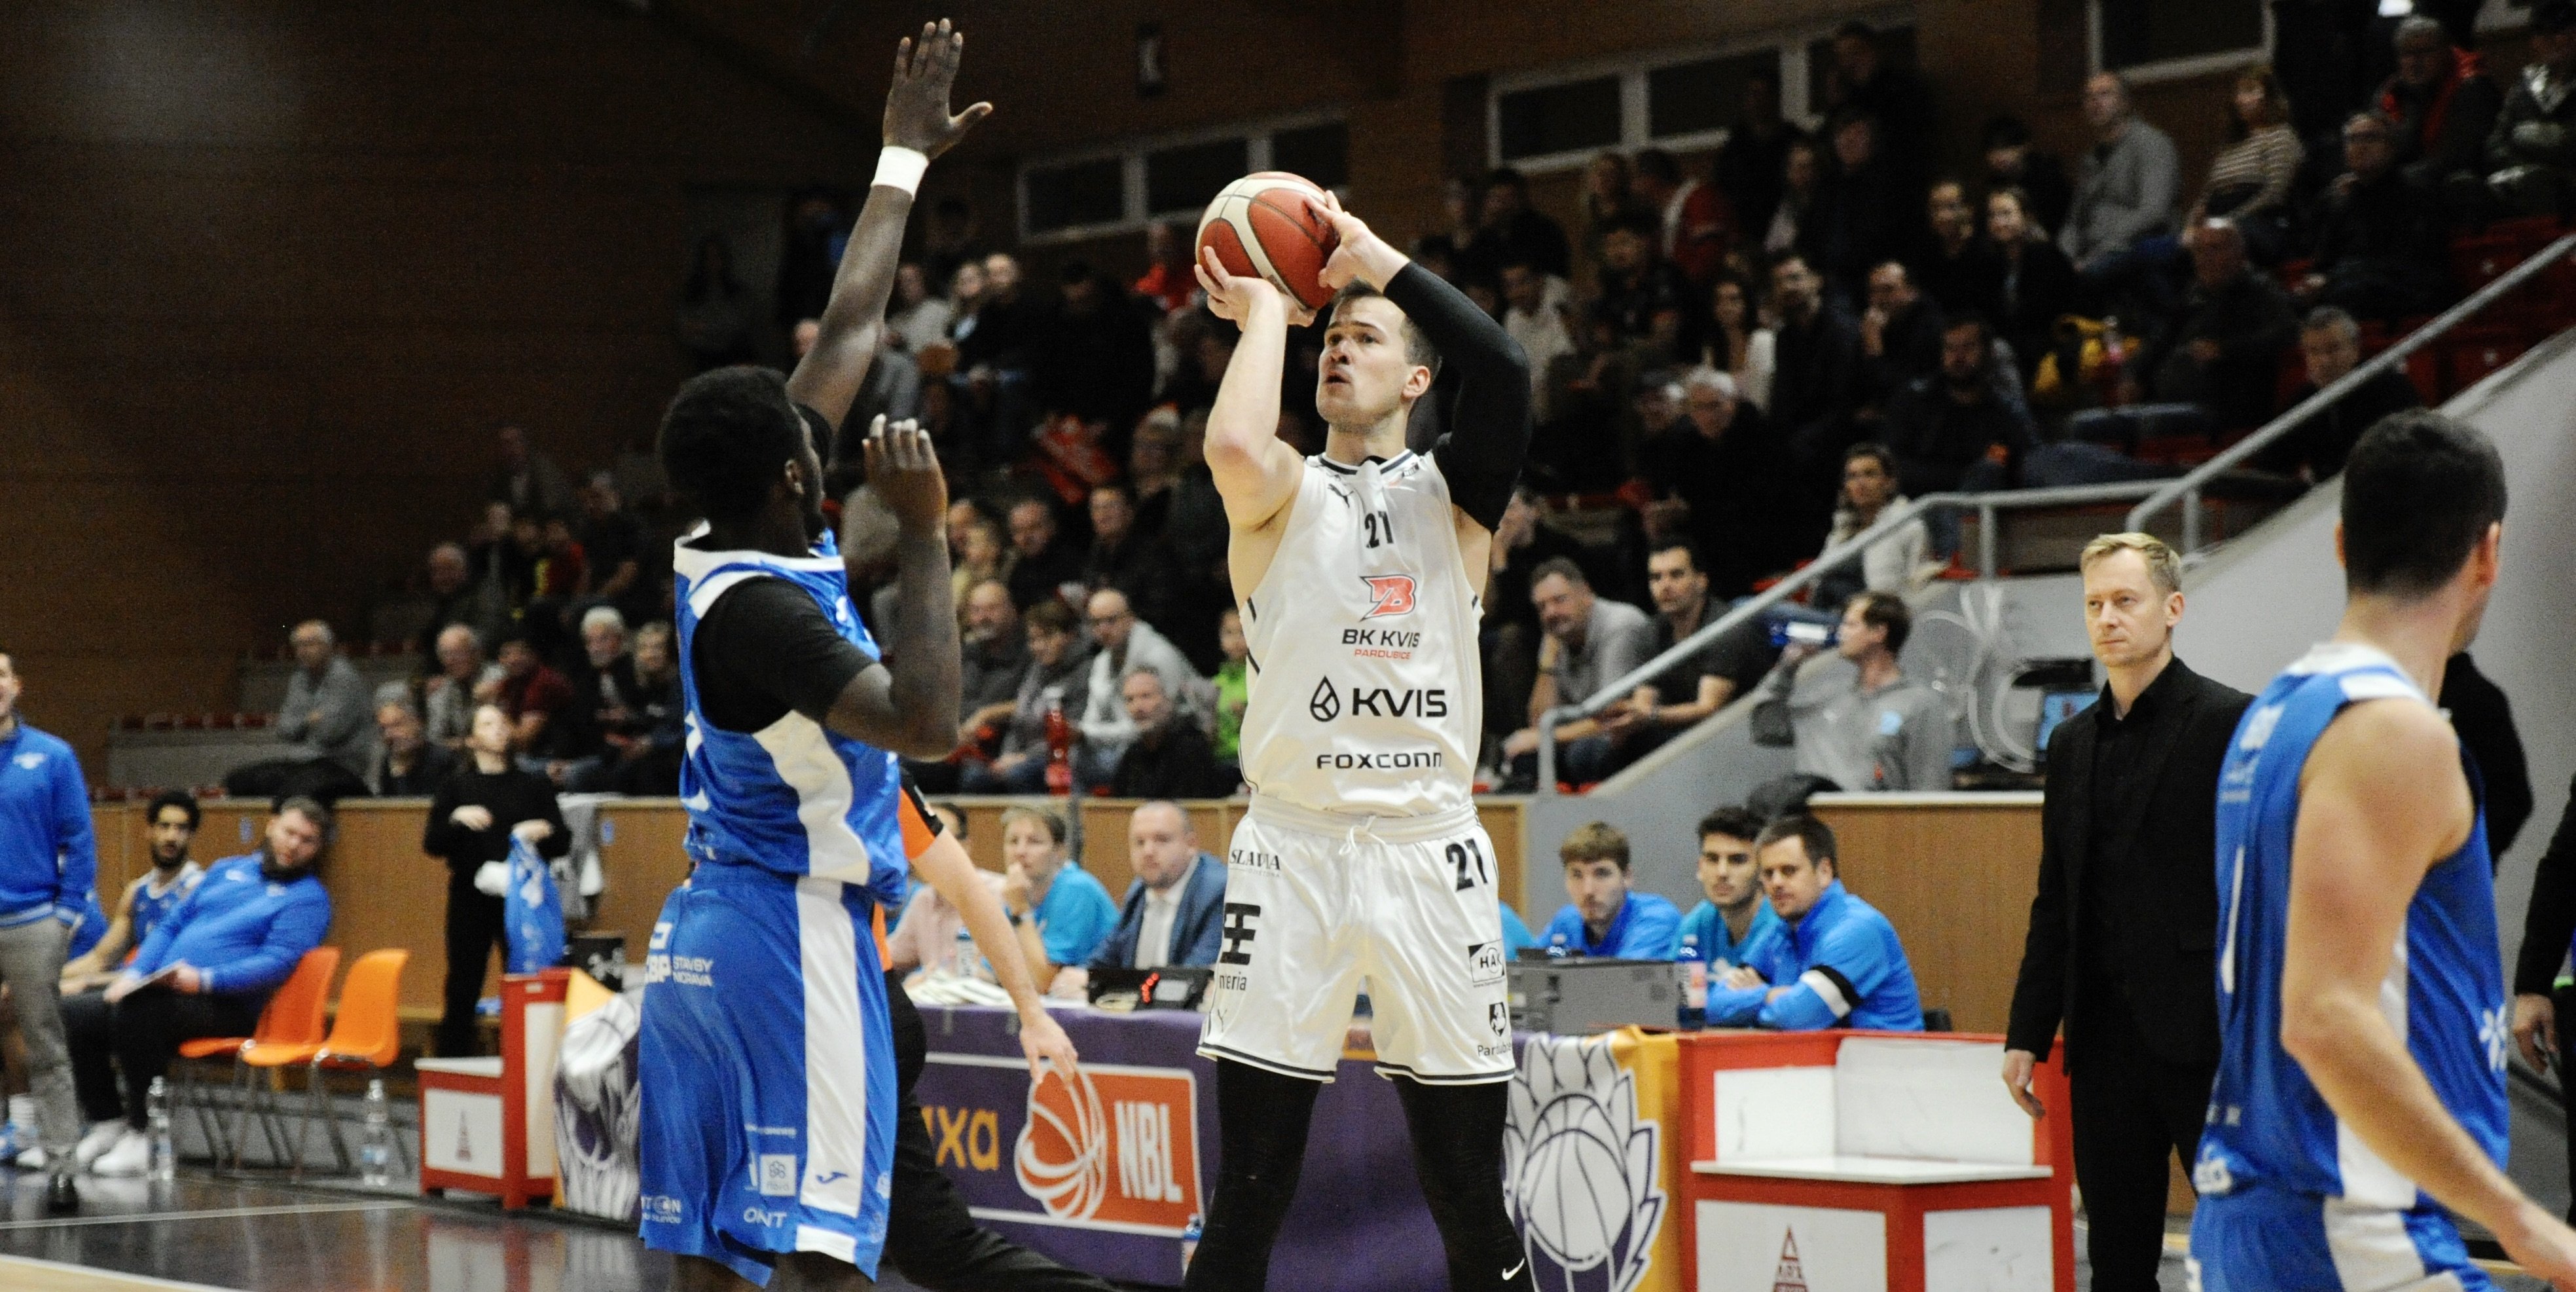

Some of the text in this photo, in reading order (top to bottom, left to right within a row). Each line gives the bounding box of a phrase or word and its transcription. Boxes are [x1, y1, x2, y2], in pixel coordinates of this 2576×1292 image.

[1364, 511, 1394, 549] 21
[1342, 629, 1421, 648] BK KVIS
[1354, 648, 1411, 659] PARDUBICE
[1352, 688, 1447, 718] KVIS
[1229, 849, 1280, 871] SLAVIA
[1445, 838, 1488, 893] 21
[1114, 1100, 1184, 1204] NBL
